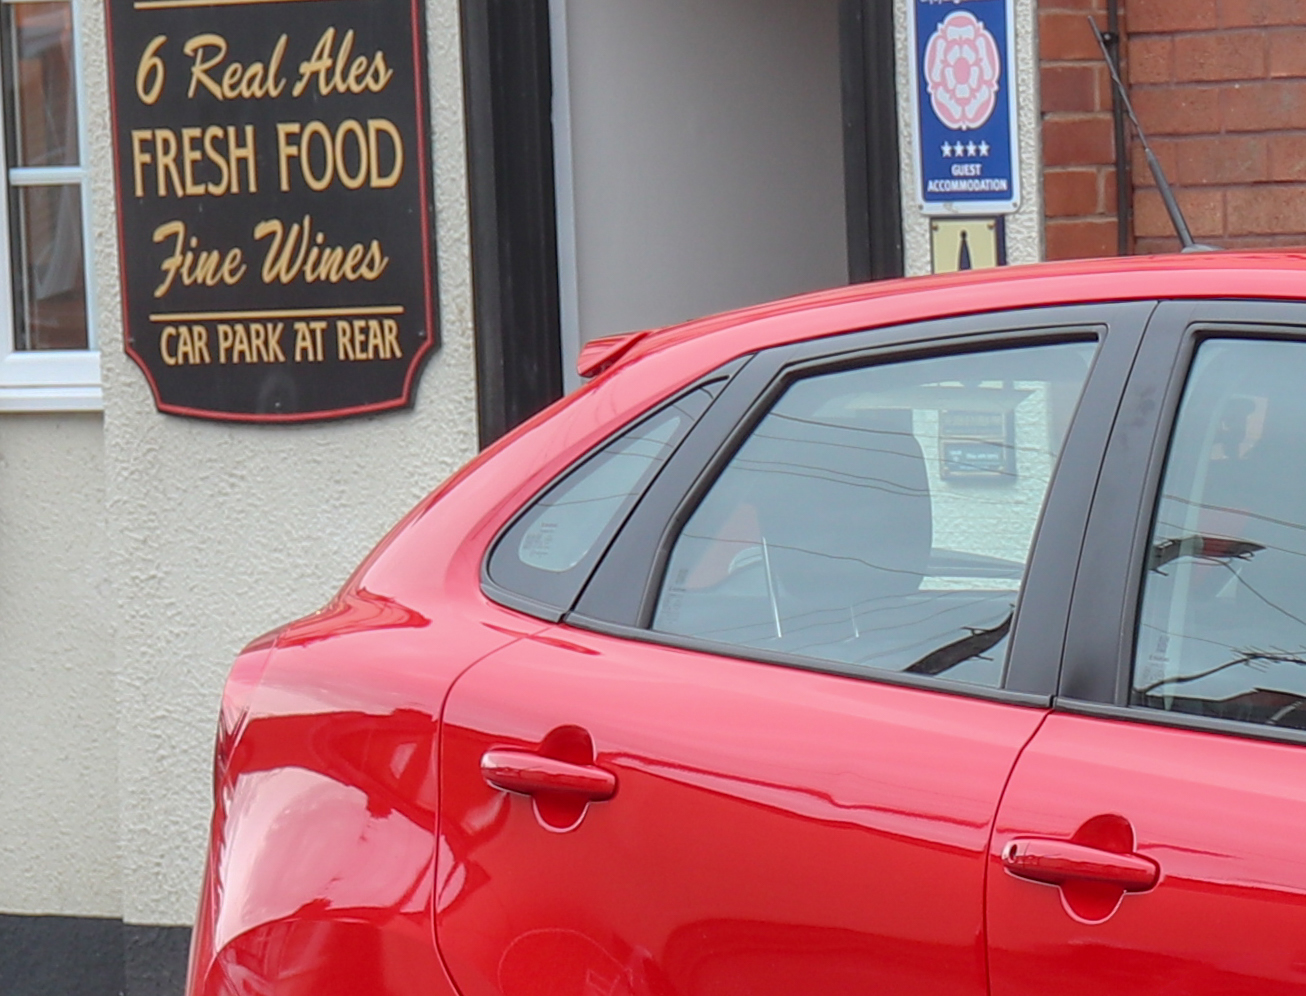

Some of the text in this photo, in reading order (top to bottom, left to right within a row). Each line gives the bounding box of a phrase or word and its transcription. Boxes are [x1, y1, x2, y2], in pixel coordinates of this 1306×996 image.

[136, 26, 393, 104] 6 Real Ales
[131, 118, 404, 198] FRESH FOOD
[927, 178, 1008, 192] ACCOMMODATION
[951, 163, 982, 177] GUEST
[152, 214, 389, 298] Fine Wines
[160, 319, 402, 366] CAR PARK AT REAR
